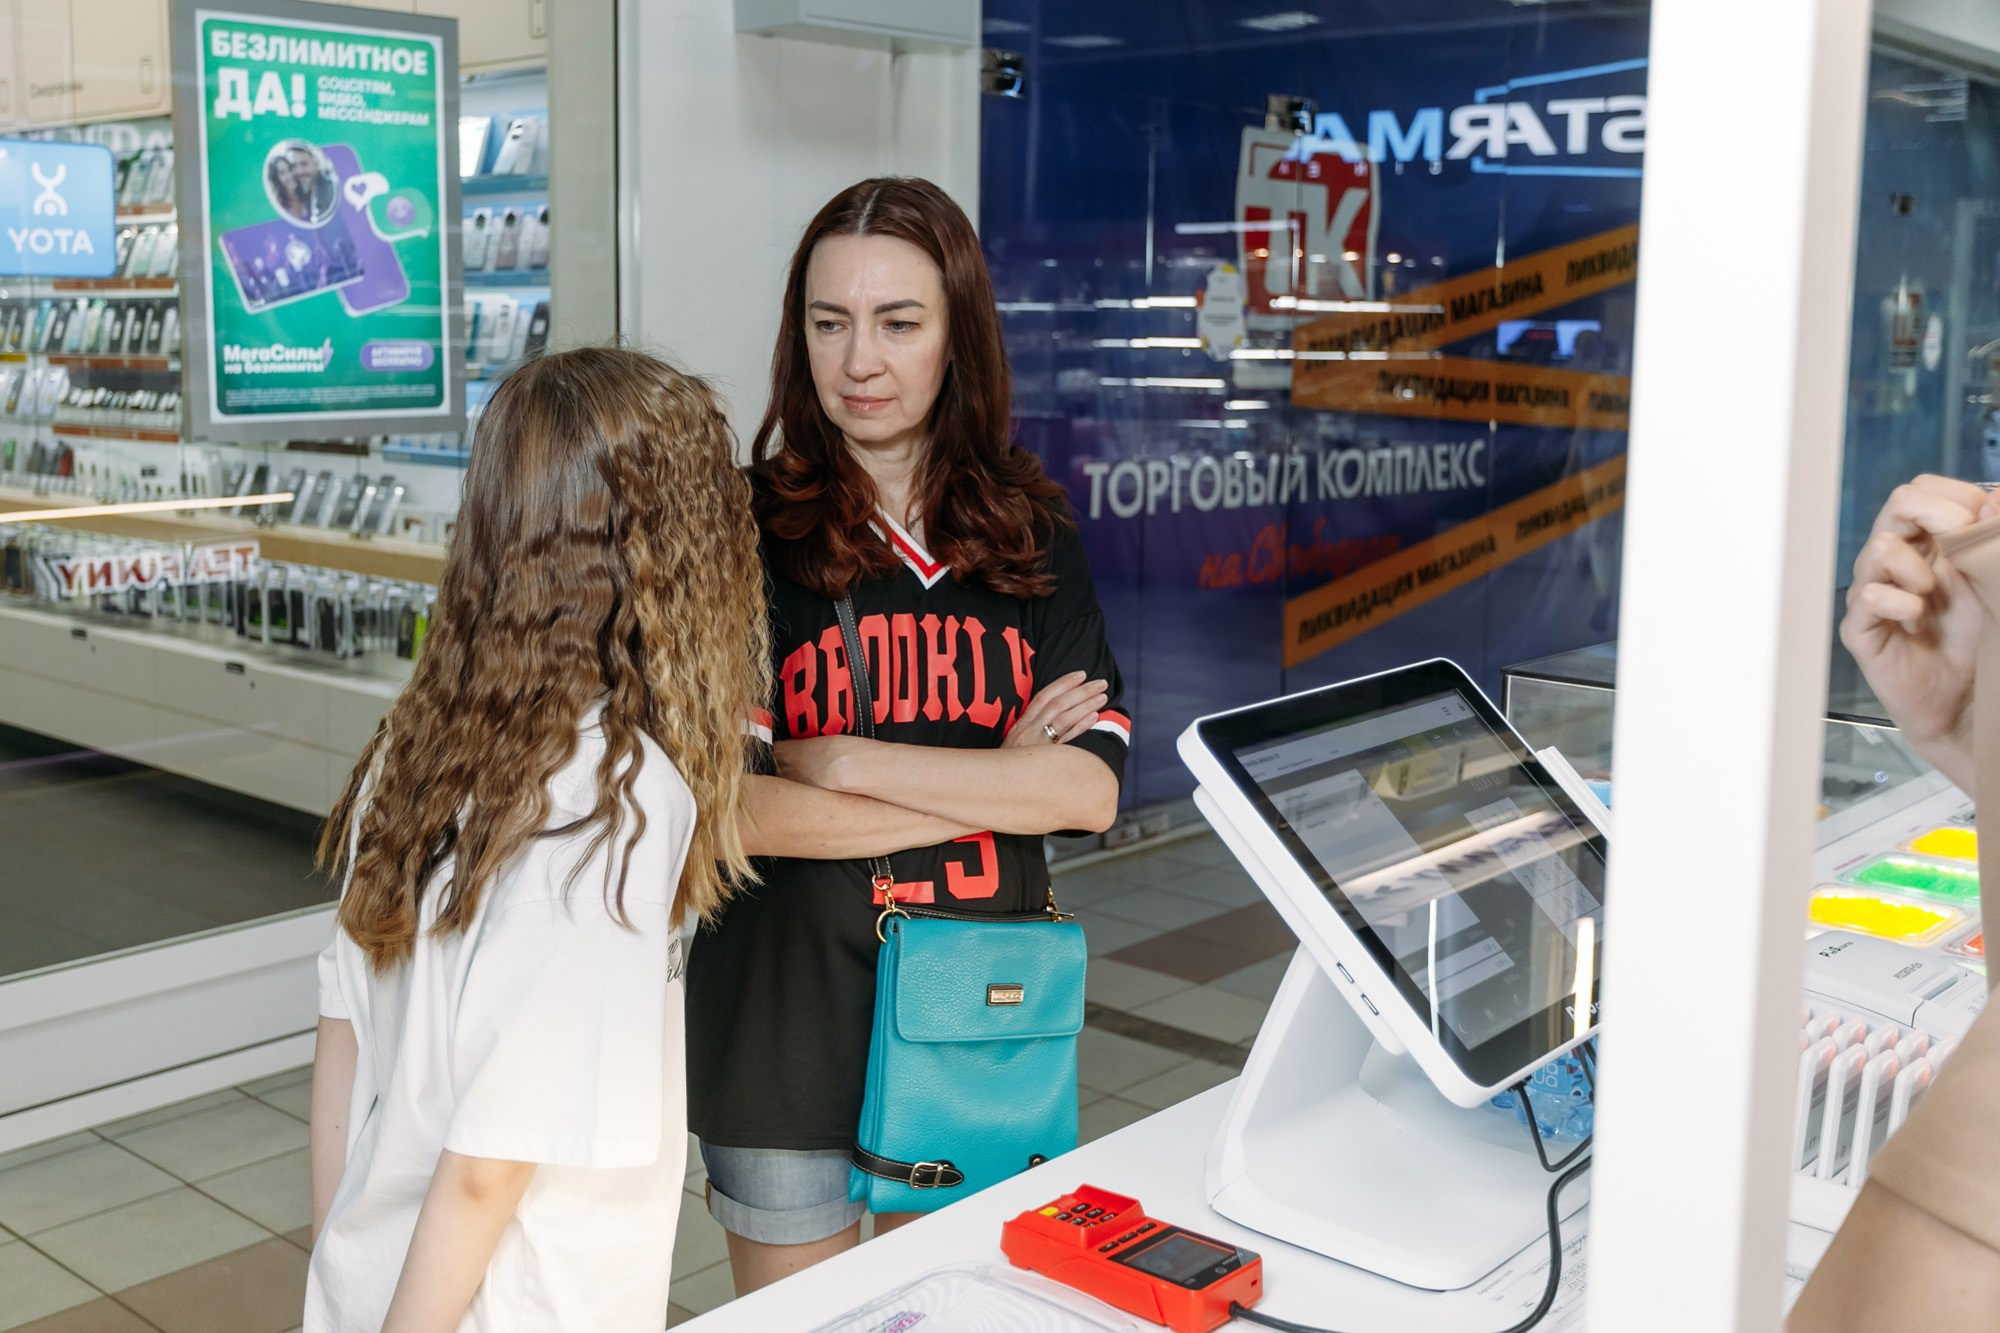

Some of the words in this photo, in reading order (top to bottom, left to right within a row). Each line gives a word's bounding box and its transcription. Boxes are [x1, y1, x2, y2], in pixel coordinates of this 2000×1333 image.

[211, 29, 428, 75] БЕЗЛИМИТНОЕ
[214, 66, 307, 121] ДА!
[8, 227, 94, 255] YOTA
[223, 343, 324, 362] МегаСилы
[1082, 447, 1308, 519] ТОРГОВЫЙ
[1317, 439, 1487, 500] КОМПЛЕКС
